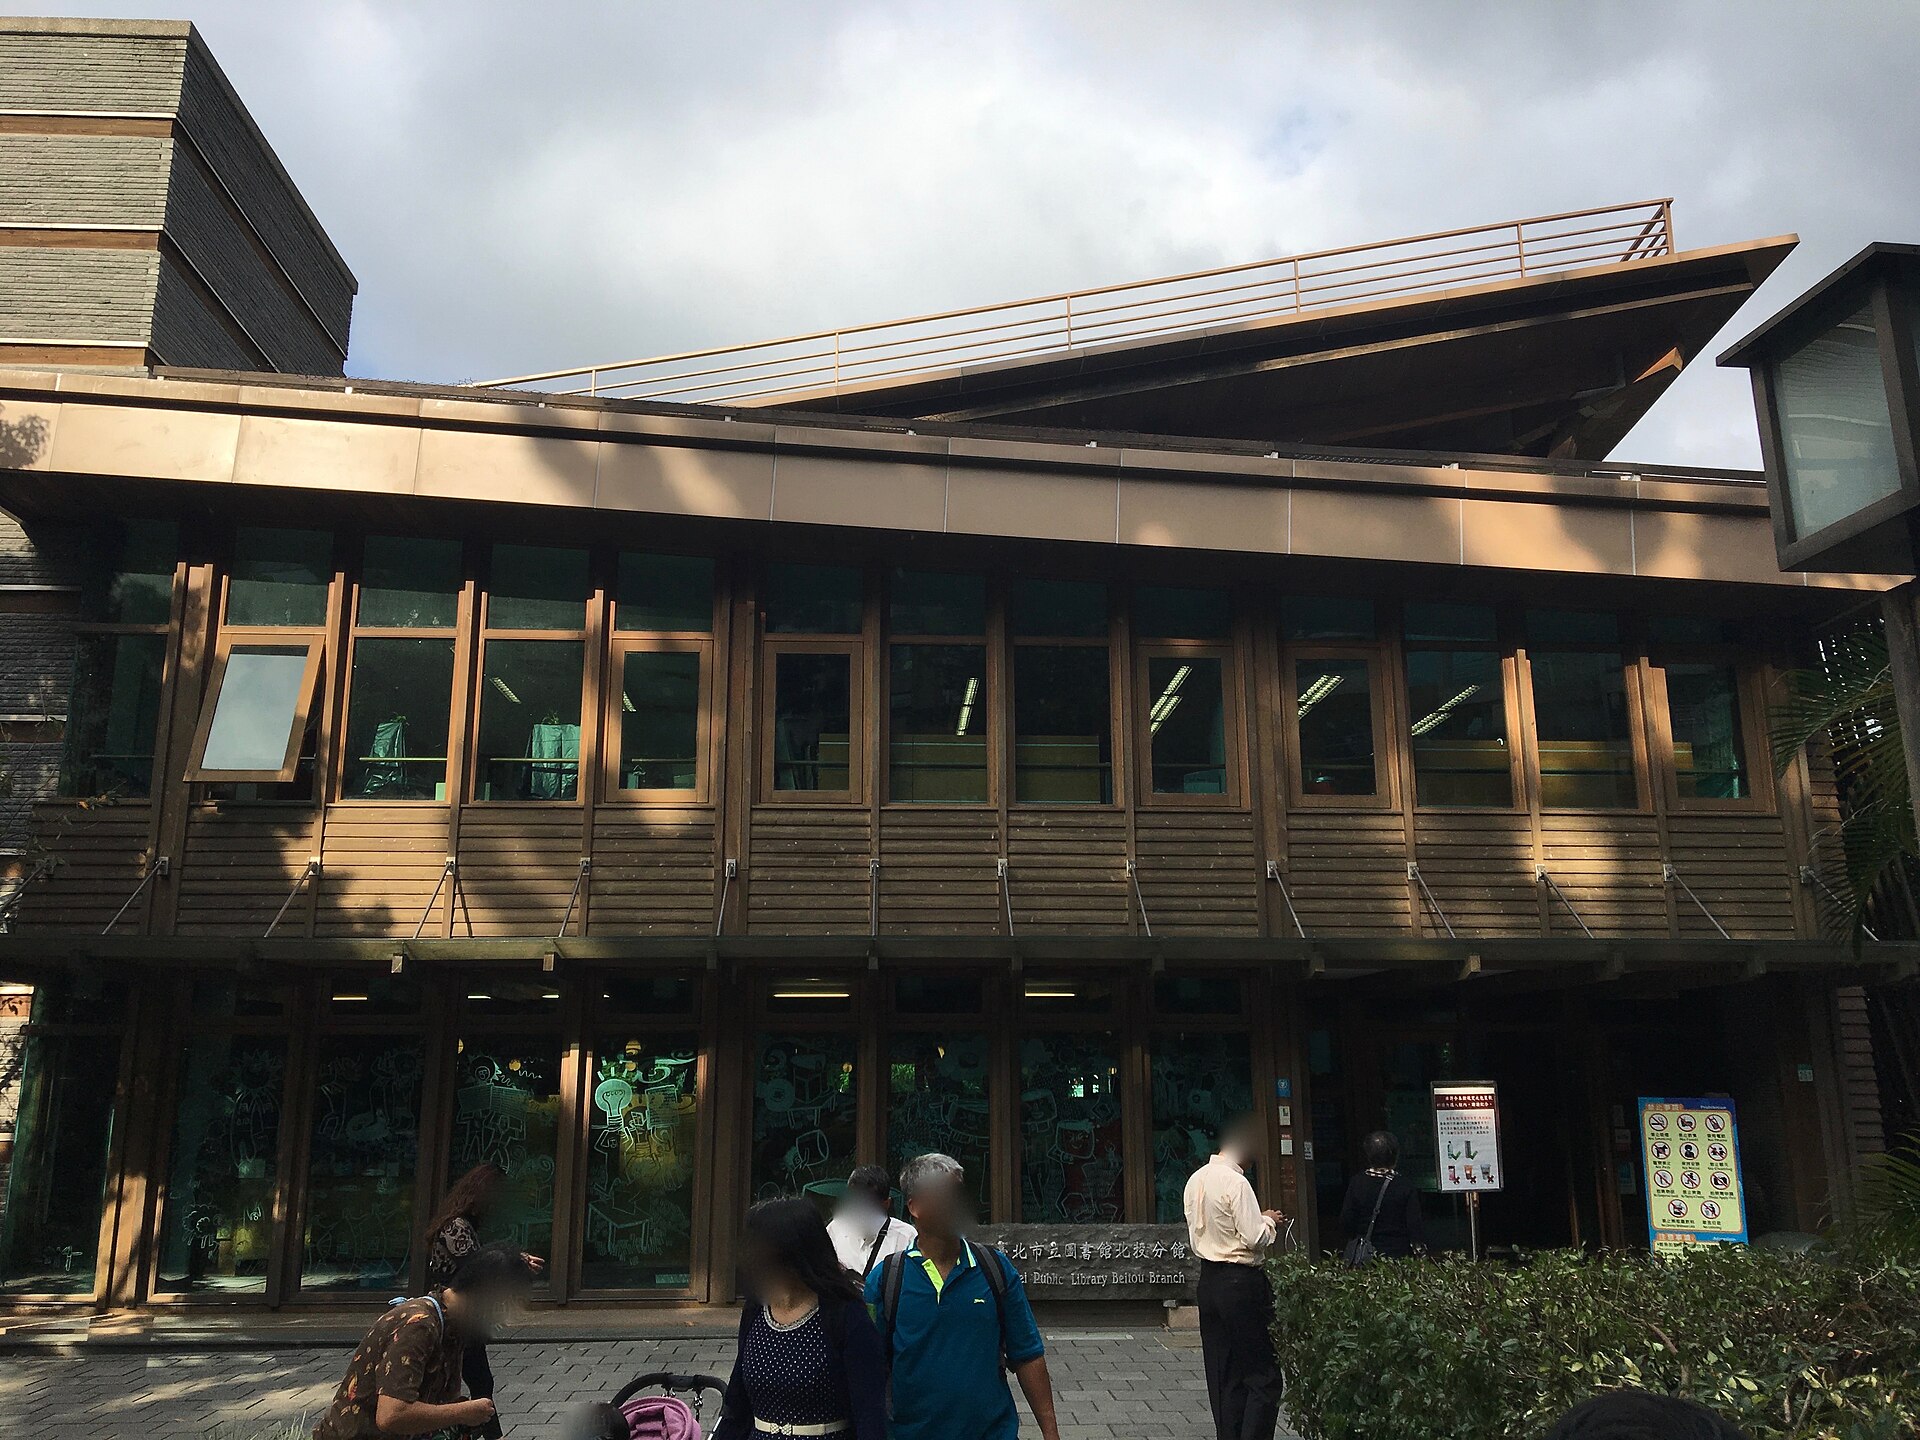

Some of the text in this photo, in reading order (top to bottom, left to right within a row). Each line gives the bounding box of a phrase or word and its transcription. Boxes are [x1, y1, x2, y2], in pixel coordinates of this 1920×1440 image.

[1033, 1272, 1063, 1284] Public
[1071, 1273, 1107, 1286] Library
[1112, 1272, 1144, 1284] Beitou
[1149, 1271, 1186, 1284] Branch
